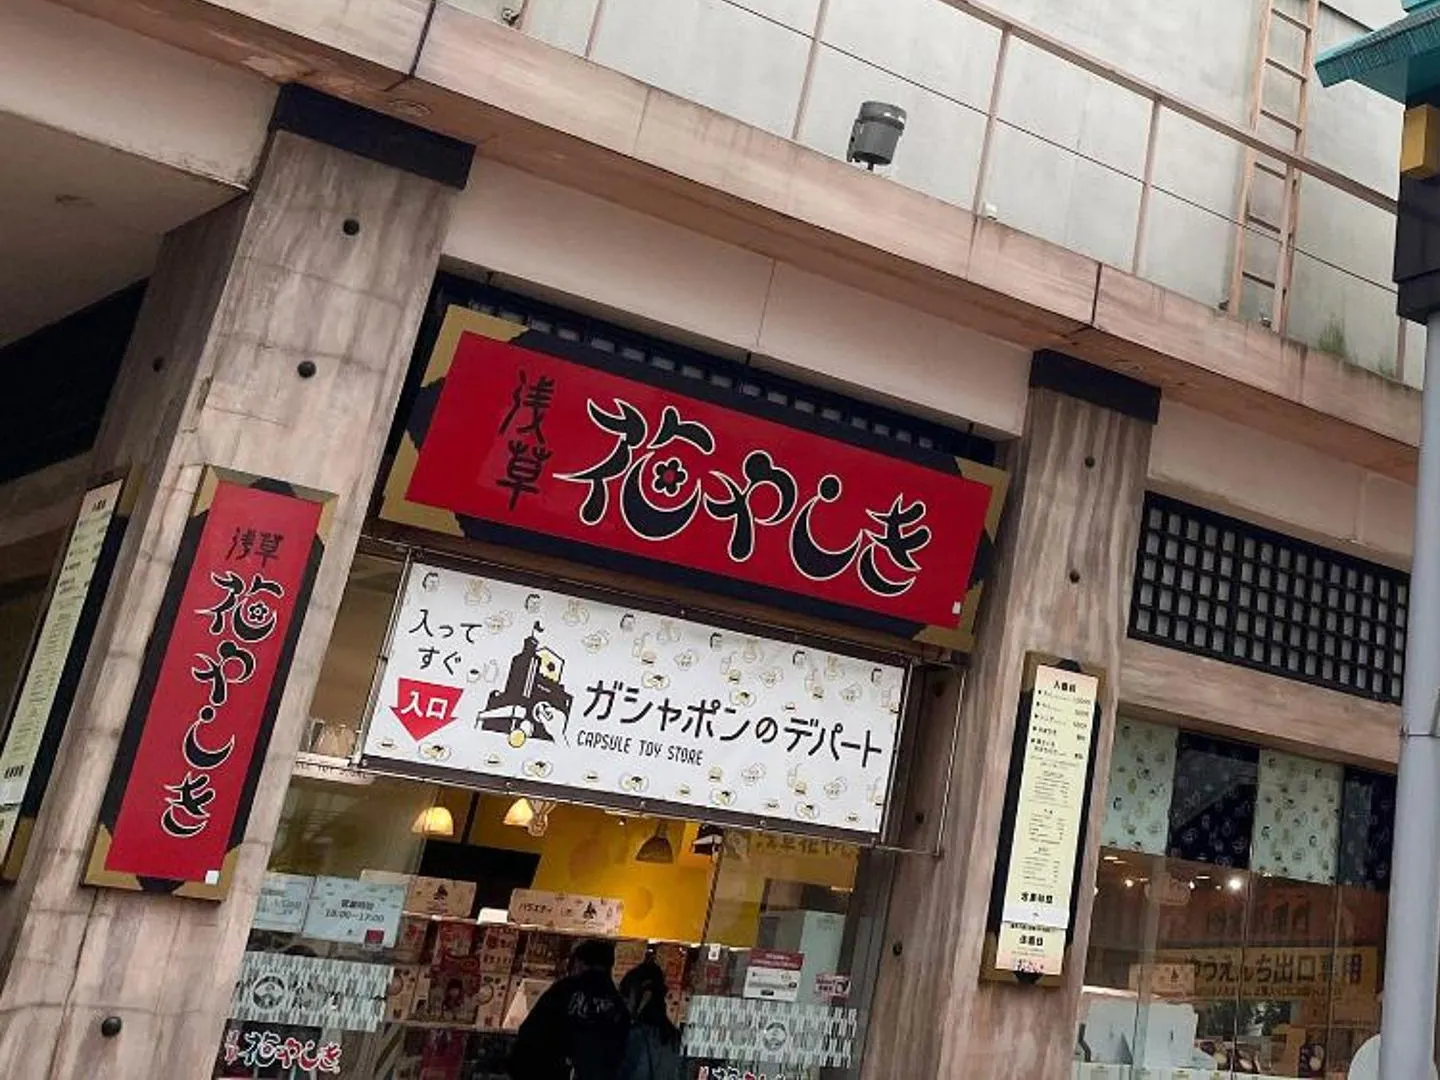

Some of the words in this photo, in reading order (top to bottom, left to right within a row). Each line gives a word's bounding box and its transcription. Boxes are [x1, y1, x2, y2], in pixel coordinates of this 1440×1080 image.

[496, 370, 556, 511] 浅草
[225, 526, 285, 568] 浅草
[409, 609, 482, 644] 入って
[418, 646, 462, 676] すぐ
[400, 690, 449, 720] 入口
[583, 679, 883, 768] ガシャポンのデパート
[577, 730, 633, 756] CAPSULE
[638, 741, 663, 759] TOY
[667, 745, 704, 766] STORE
